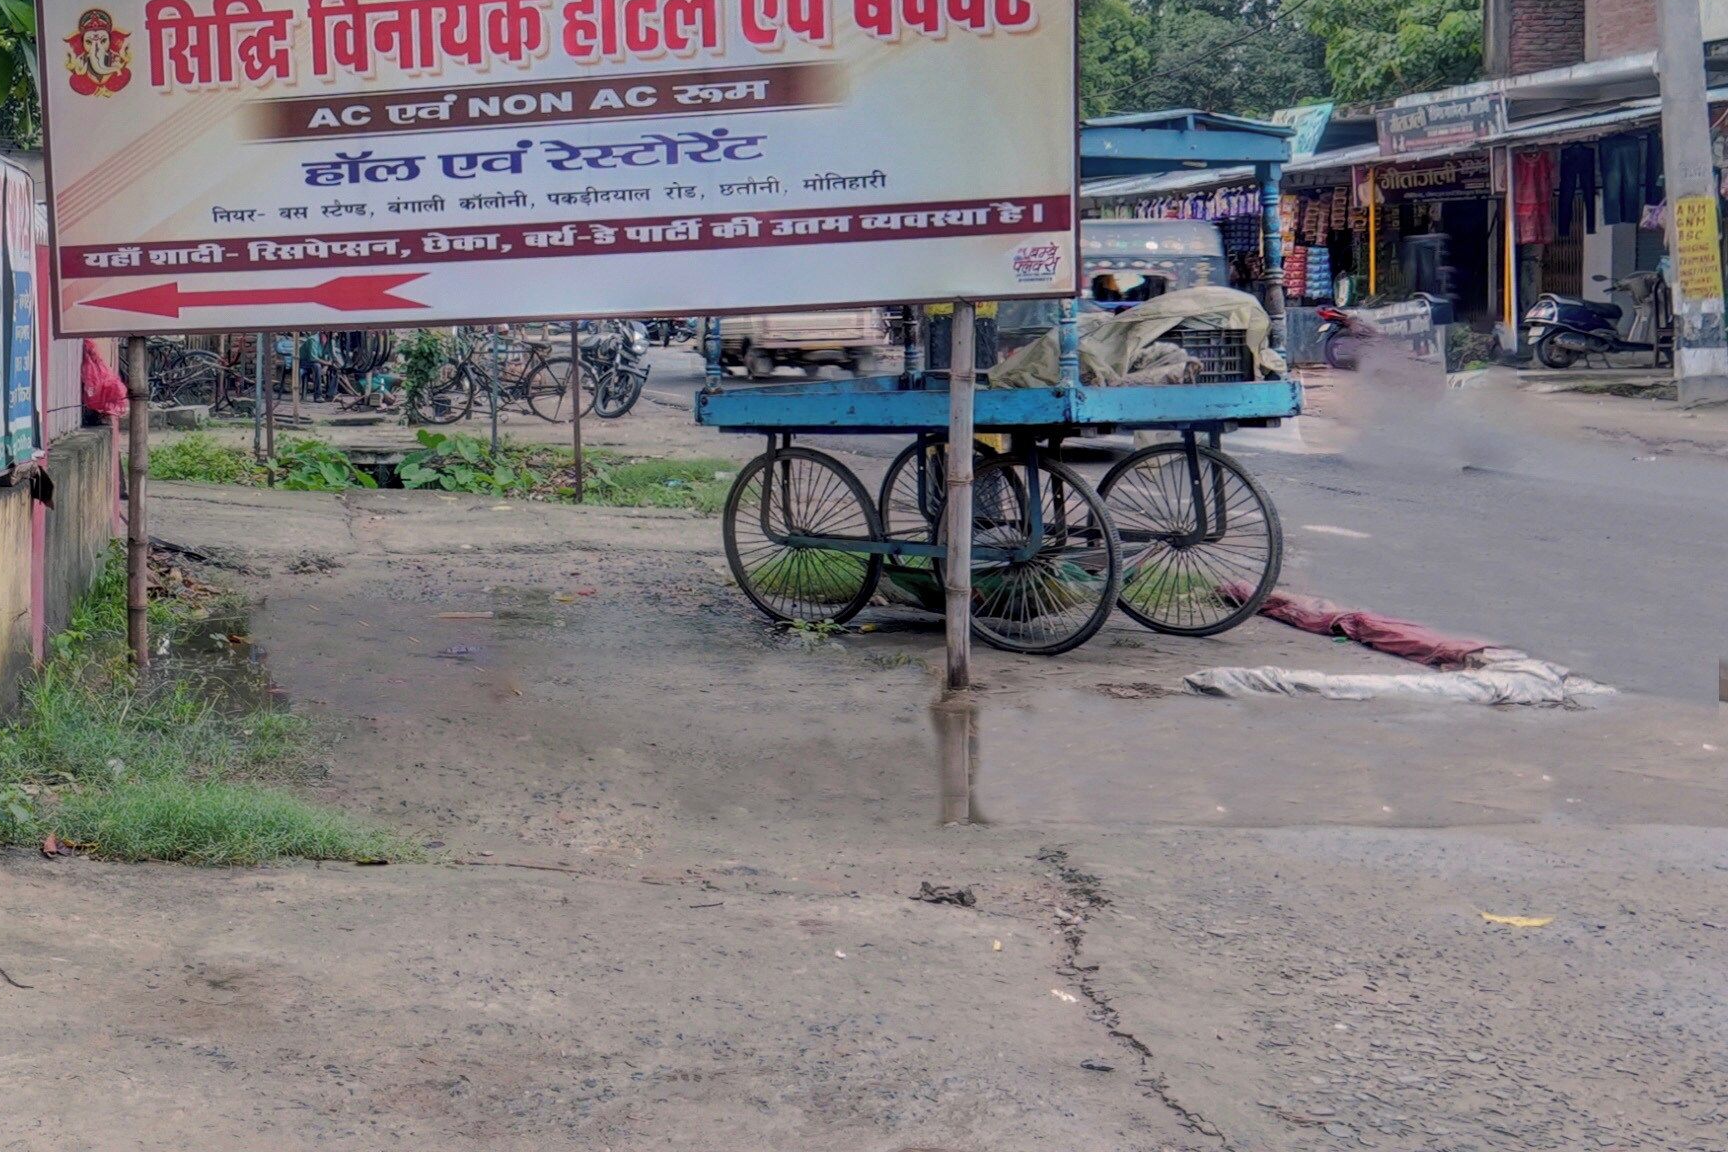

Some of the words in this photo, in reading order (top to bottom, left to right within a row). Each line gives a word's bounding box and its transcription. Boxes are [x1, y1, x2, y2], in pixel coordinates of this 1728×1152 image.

[307, 104, 372, 128] AC
[384, 94, 458, 125] एवं
[469, 90, 574, 118] NON
[589, 85, 658, 111] AC
[672, 79, 770, 105] रूम
[302, 150, 426, 187] हॉल
[438, 138, 533, 179] एवं
[545, 127, 769, 170] रेस्टोरेंट
[279, 205, 309, 221] बस
[388, 194, 446, 215] बंगाली
[459, 189, 536, 211] कॉलोनी,
[546, 185, 651, 208] पकड़ीदयाल
[663, 181, 706, 201] रोड,
[802, 168, 888, 192] मोतिहारी
[83, 246, 143, 269] यहाँ
[624, 217, 703, 242] पार्टी
[712, 215, 762, 240] की
[858, 207, 992, 230] व्यवस्था
